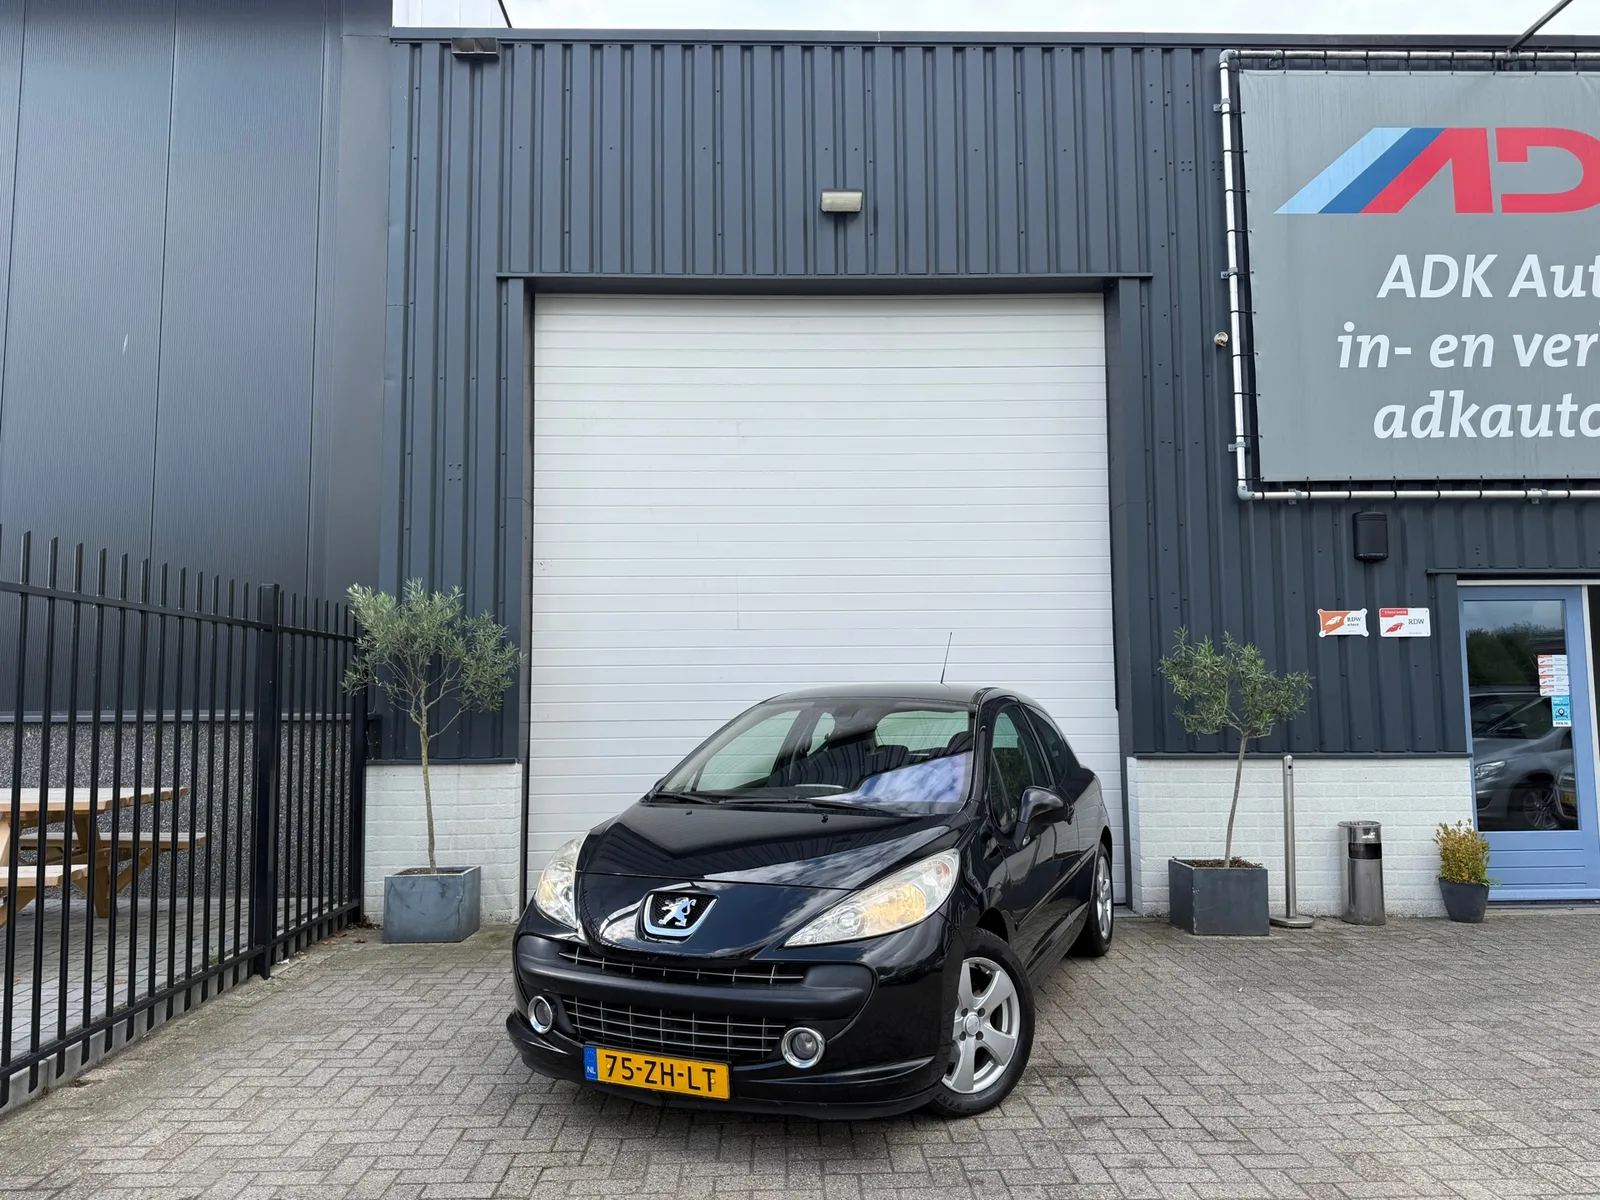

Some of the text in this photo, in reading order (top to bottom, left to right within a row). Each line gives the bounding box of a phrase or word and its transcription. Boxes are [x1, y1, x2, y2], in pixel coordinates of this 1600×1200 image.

[1376, 254, 1498, 298] ADK
[1337, 320, 1600, 368] in- en ver
[586, 1065, 597, 1075] NL
[605, 1054, 716, 1092] 75-ZH-LT
